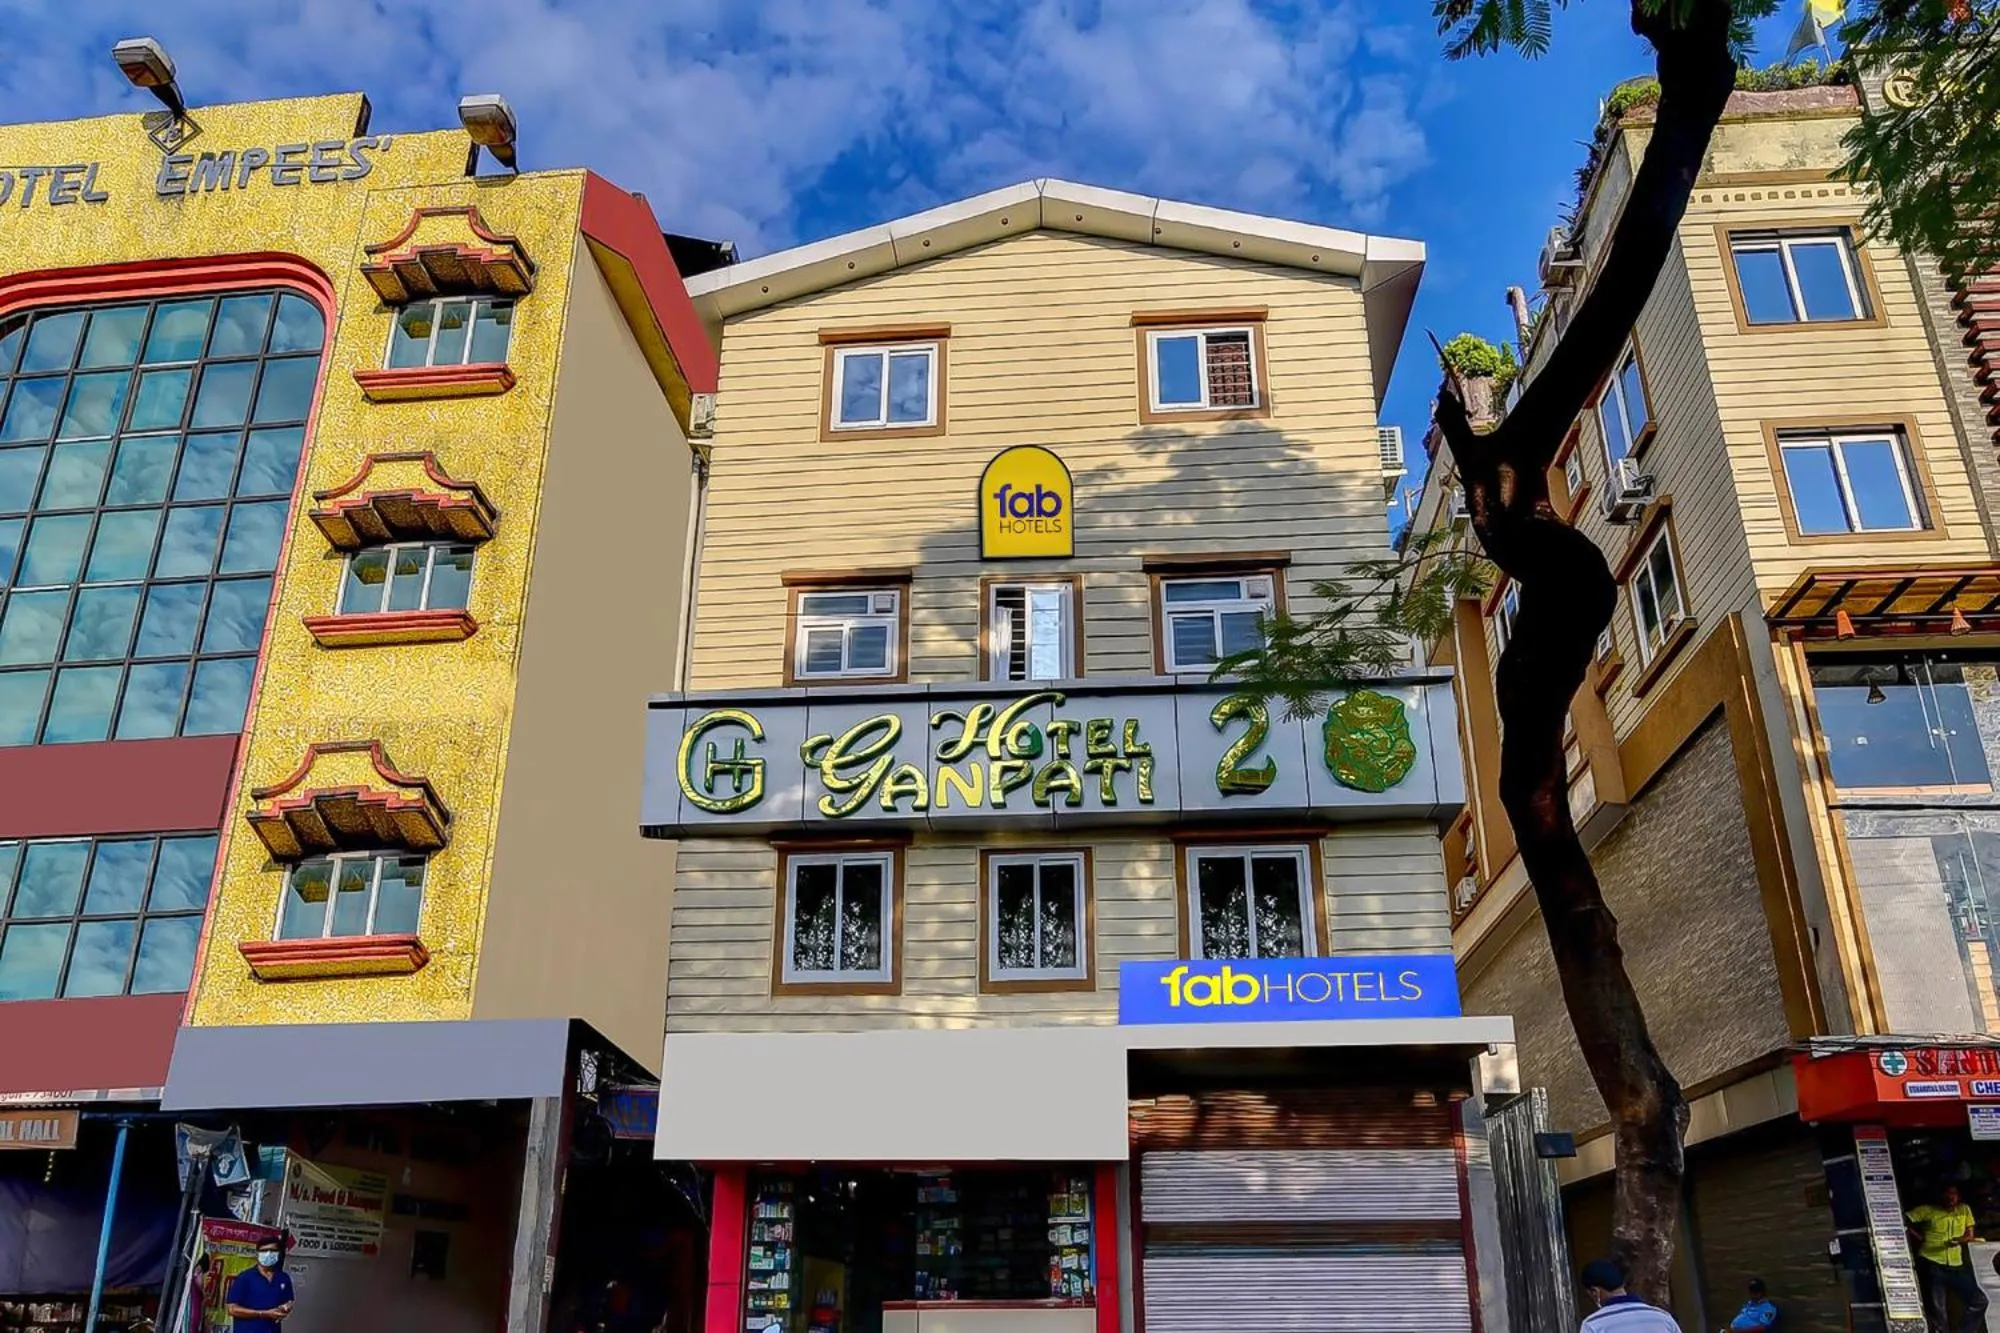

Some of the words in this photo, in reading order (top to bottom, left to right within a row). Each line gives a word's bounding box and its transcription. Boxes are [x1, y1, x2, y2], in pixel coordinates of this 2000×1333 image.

[993, 483, 1063, 518] fab
[999, 519, 1062, 534] HOTELS
[1209, 694, 1277, 799] 2
